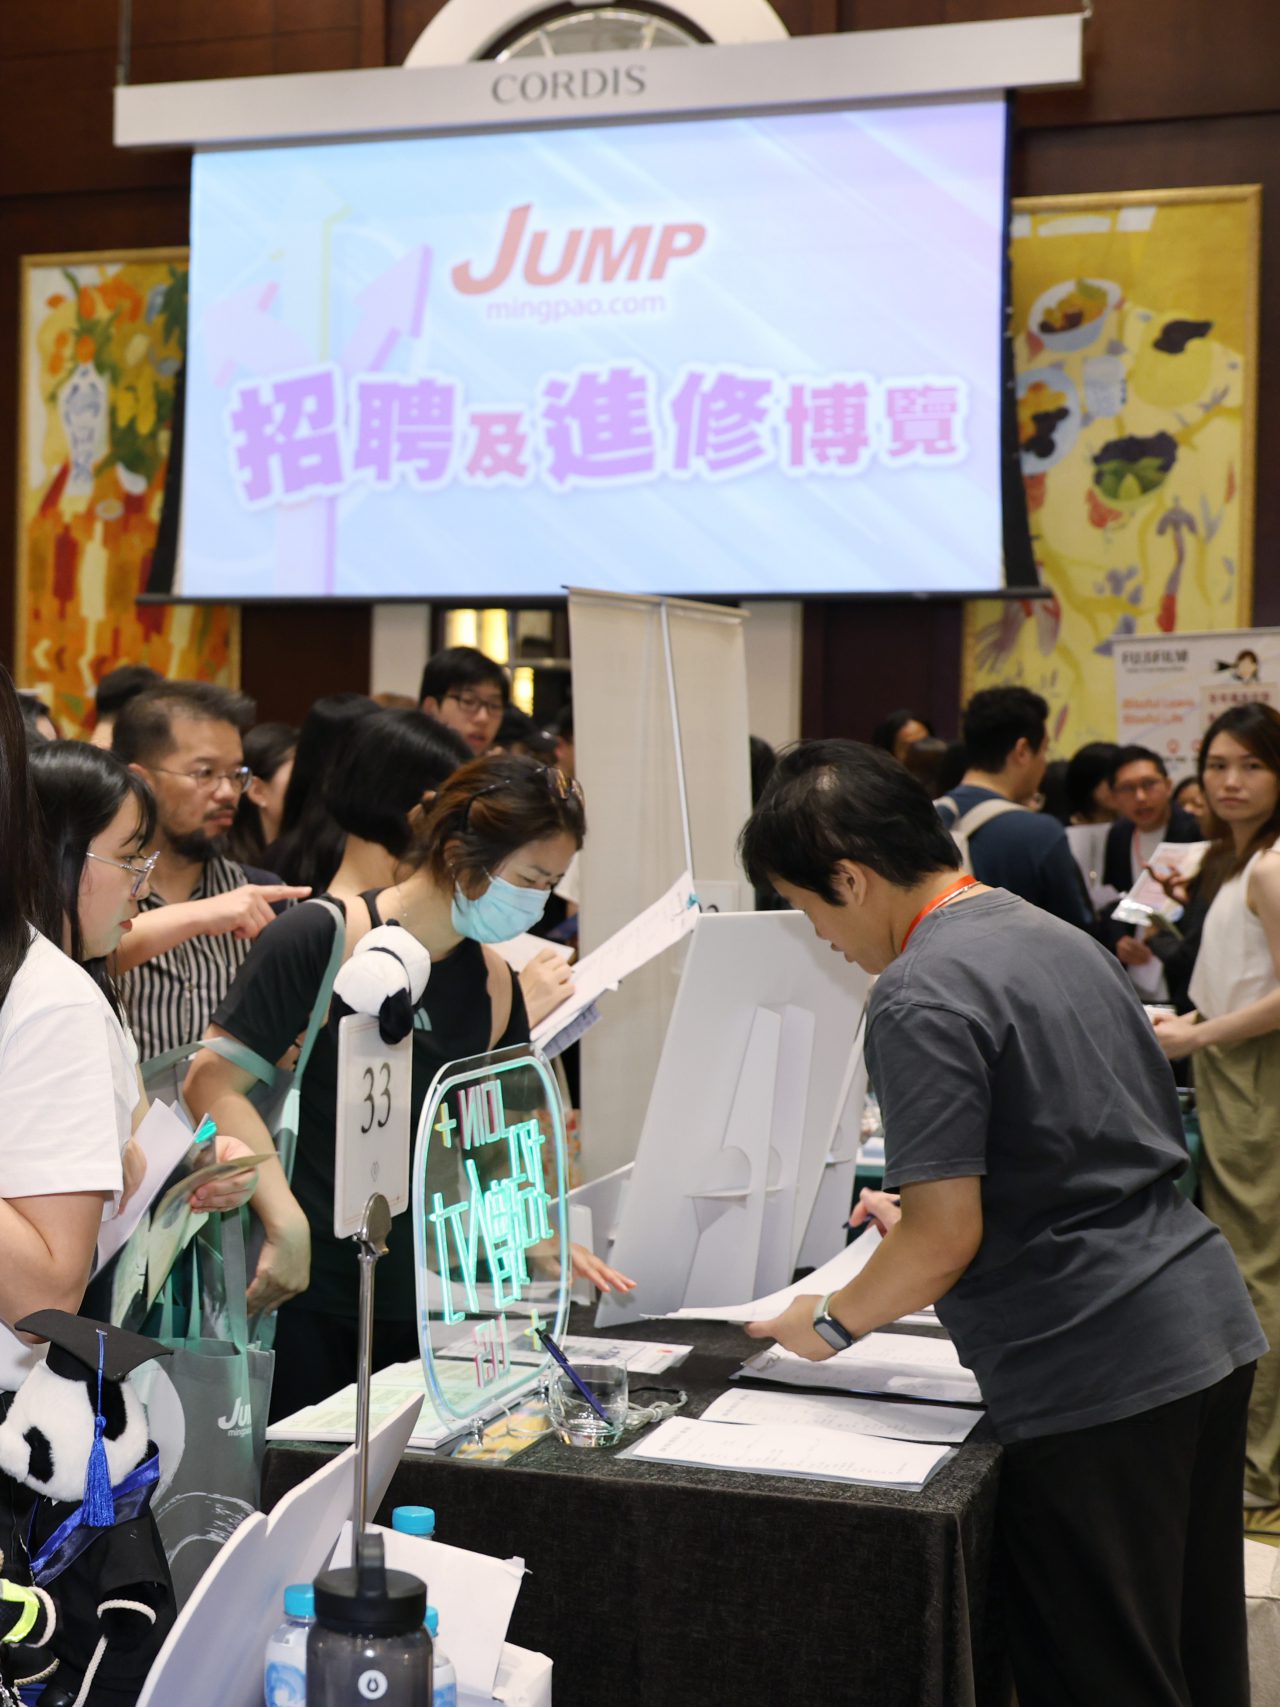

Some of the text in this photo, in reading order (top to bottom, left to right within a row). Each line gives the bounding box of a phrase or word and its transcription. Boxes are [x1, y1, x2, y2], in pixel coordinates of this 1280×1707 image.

[491, 64, 647, 105] CORDIS
[451, 202, 707, 296] JUMP
[486, 294, 666, 325] mingpao.com
[230, 369, 959, 501] 招聘及進修博覽
[360, 1062, 392, 1134] 33
